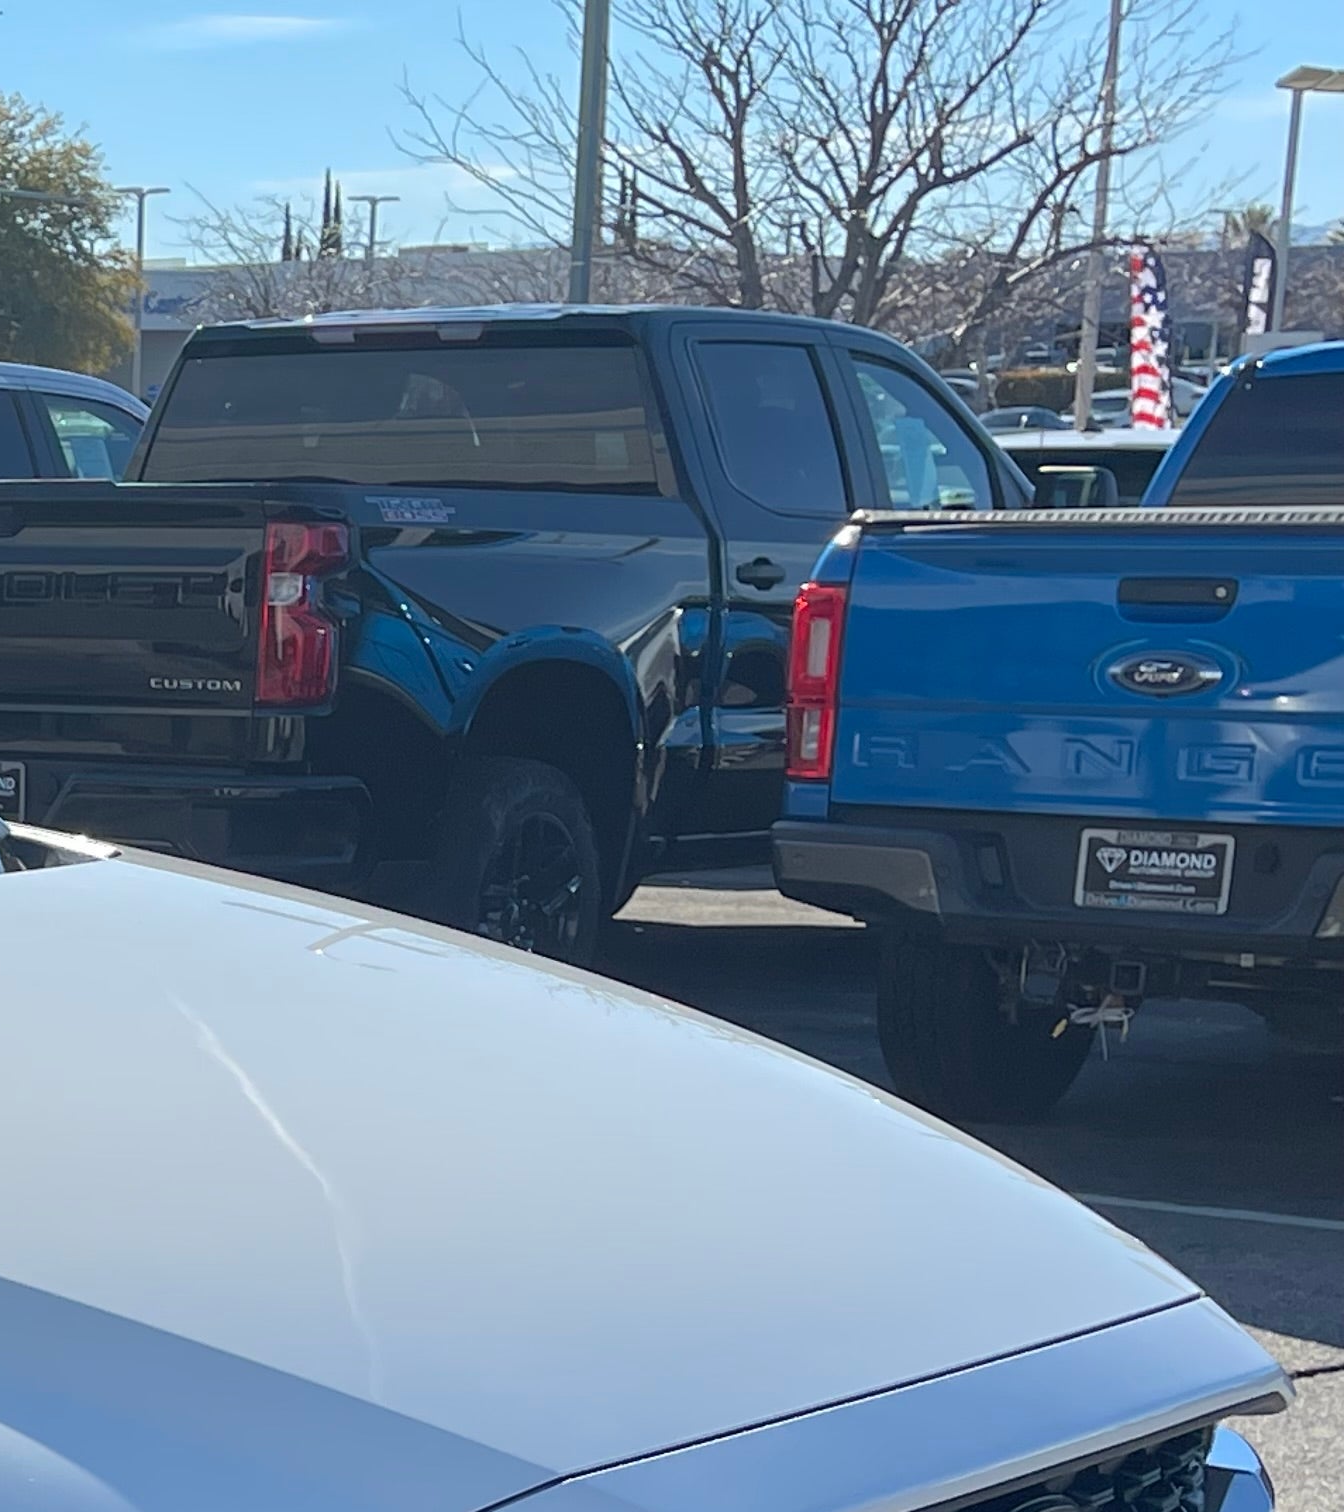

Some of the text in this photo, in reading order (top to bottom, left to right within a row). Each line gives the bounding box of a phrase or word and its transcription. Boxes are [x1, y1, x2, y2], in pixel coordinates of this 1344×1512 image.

[1133, 661, 1185, 683] Ford
[149, 677, 242, 692] CUSTOM
[1129, 849, 1217, 869] DIAMOND
